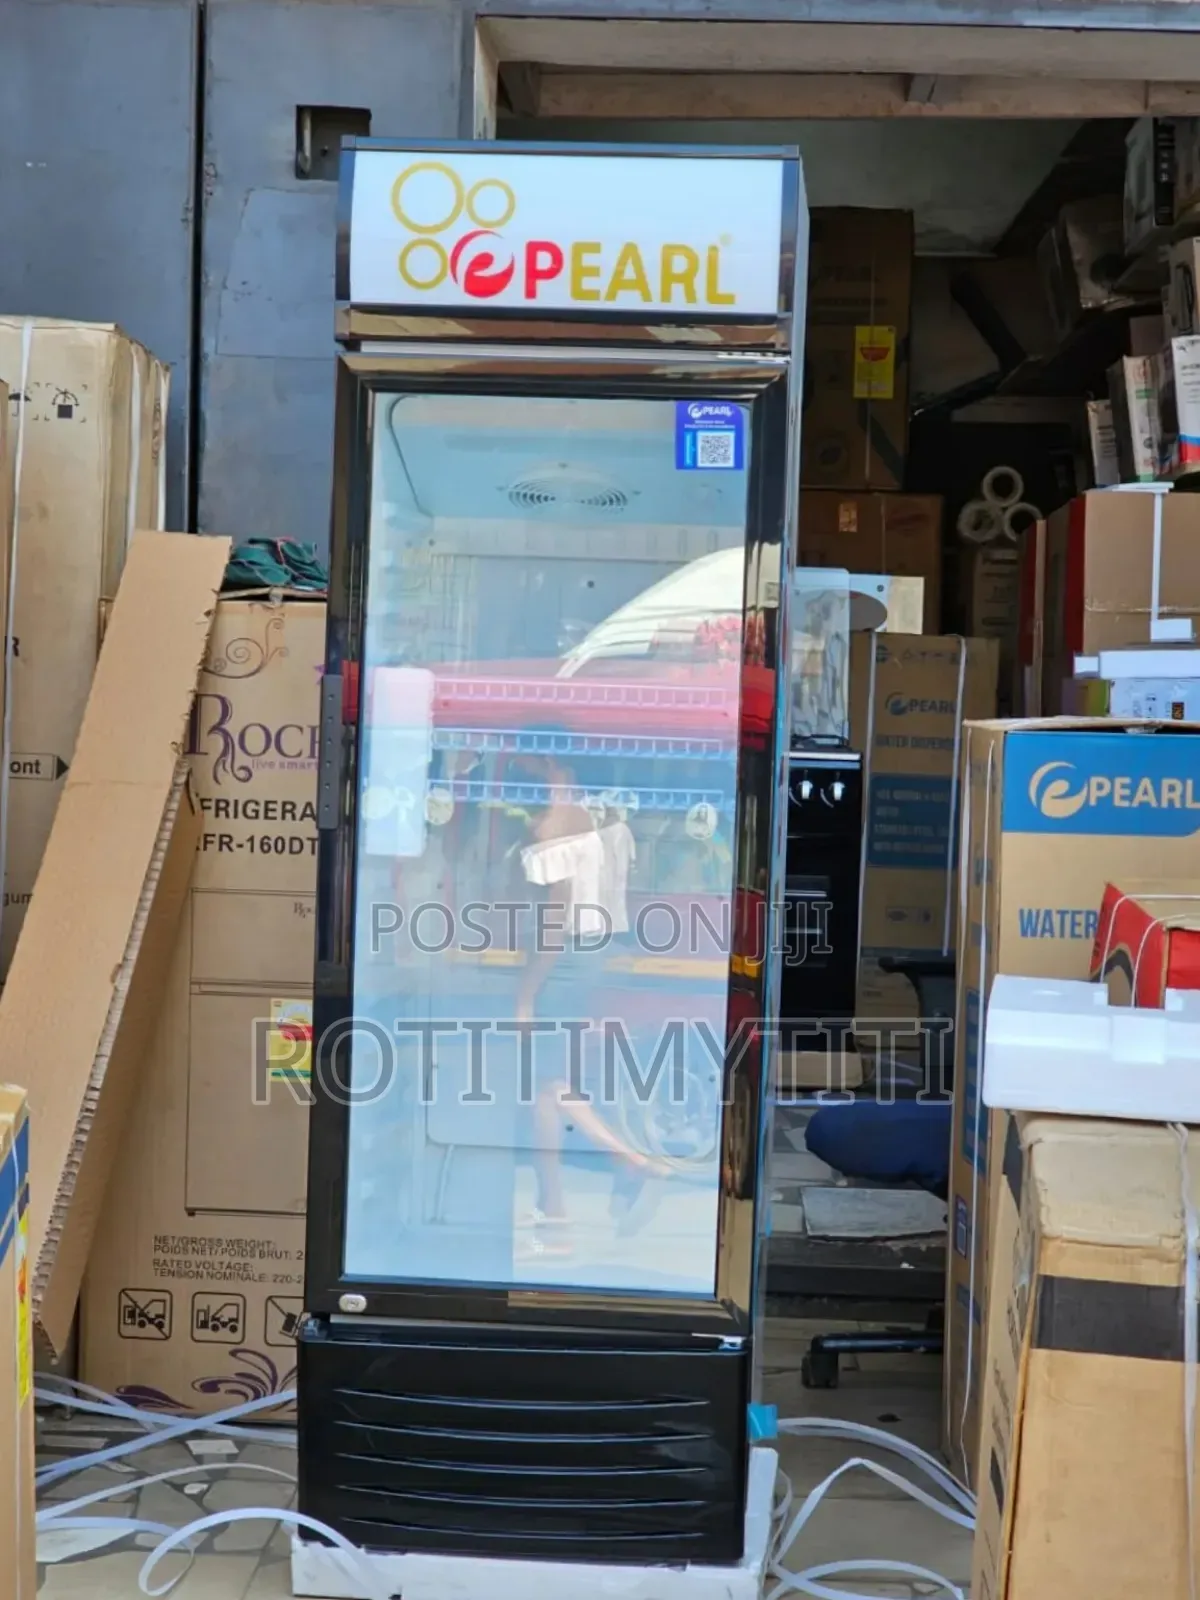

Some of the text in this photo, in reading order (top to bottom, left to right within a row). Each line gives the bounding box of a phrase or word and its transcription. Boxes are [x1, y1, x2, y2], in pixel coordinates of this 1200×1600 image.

[524, 240, 736, 305] PEARL
[9, 759, 41, 775] ont
[1088, 775, 1200, 809] PEARL
[199, 797, 318, 823] FRIGERA
[196, 832, 318, 857] FR-160DT
[1018, 908, 1099, 940] WATER
[152, 1258, 192, 1270] RATED
[272, 1273, 304, 1285] 220-2
